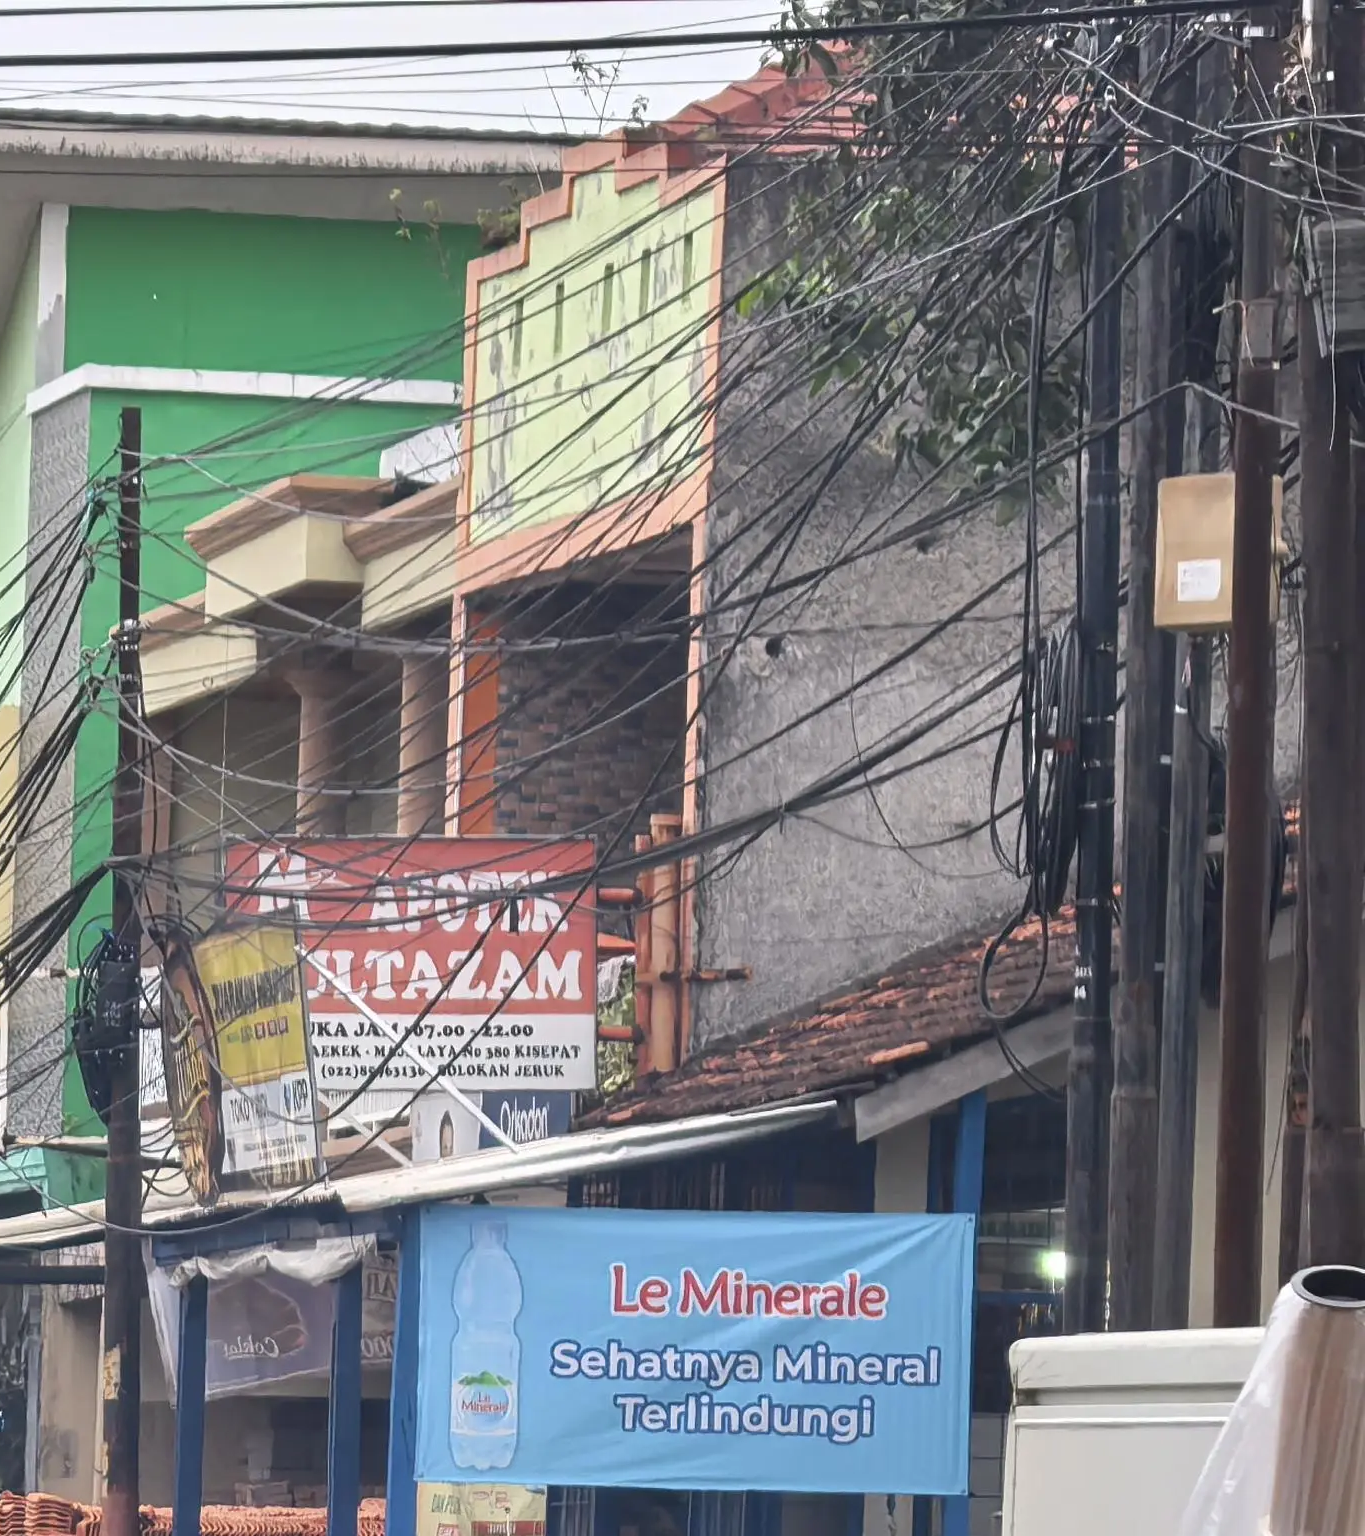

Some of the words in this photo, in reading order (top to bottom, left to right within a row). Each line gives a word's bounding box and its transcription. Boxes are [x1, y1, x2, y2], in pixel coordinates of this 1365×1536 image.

[611, 1263, 670, 1315] Le
[679, 1268, 887, 1319] Minerale
[551, 1340, 760, 1388] Sehatnya
[774, 1345, 940, 1385] Mineral
[616, 1393, 875, 1443] Terlindungi
